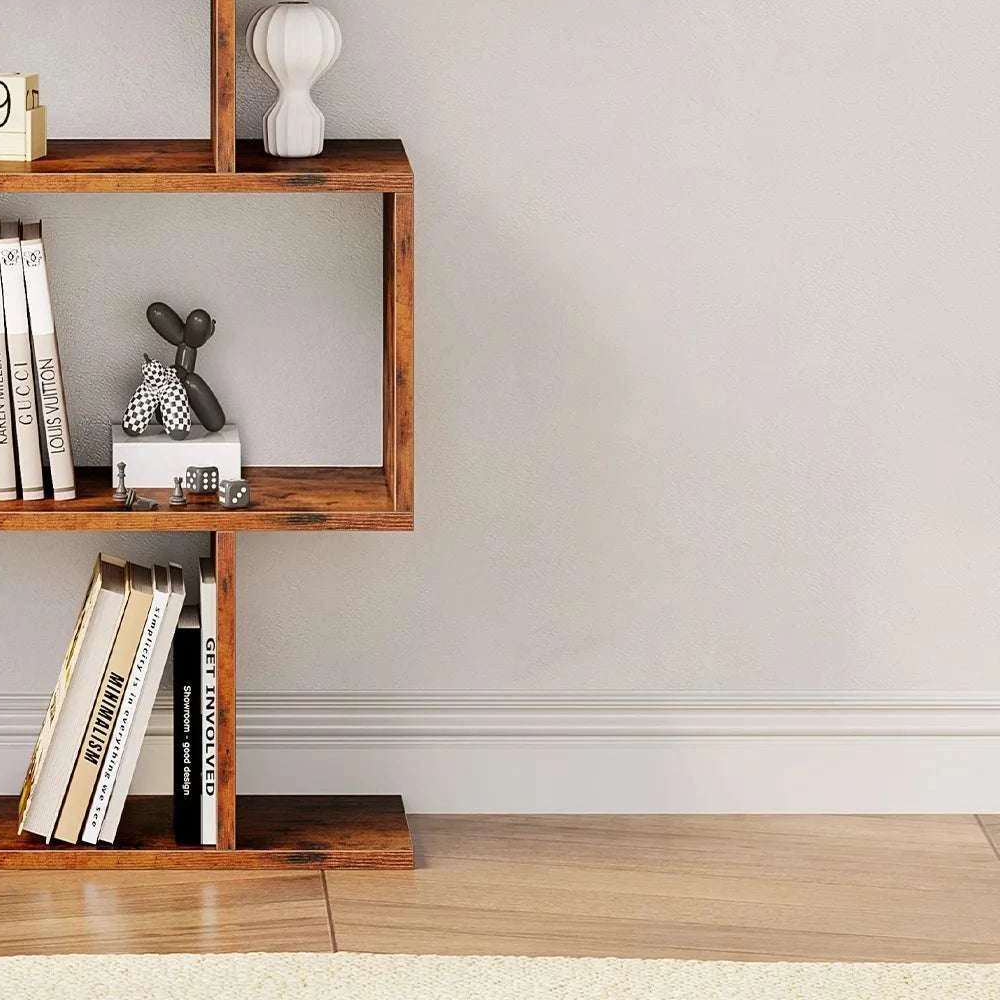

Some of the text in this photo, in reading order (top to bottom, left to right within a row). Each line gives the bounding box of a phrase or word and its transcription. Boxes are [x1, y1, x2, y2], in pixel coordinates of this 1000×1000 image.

[14, 362, 33, 425] GUCCI
[39, 358, 66, 454] LOUIS VUITTON
[136, 606, 160, 673] simplicity
[84, 671, 125, 766] MINIMALISM
[127, 692, 137, 705] in
[183, 685, 192, 733] Showroom
[205, 638, 216, 797] GET INVOLVED
[104, 709, 130, 779] everything
[182, 741, 192, 764] good
[182, 766, 192, 796] design
